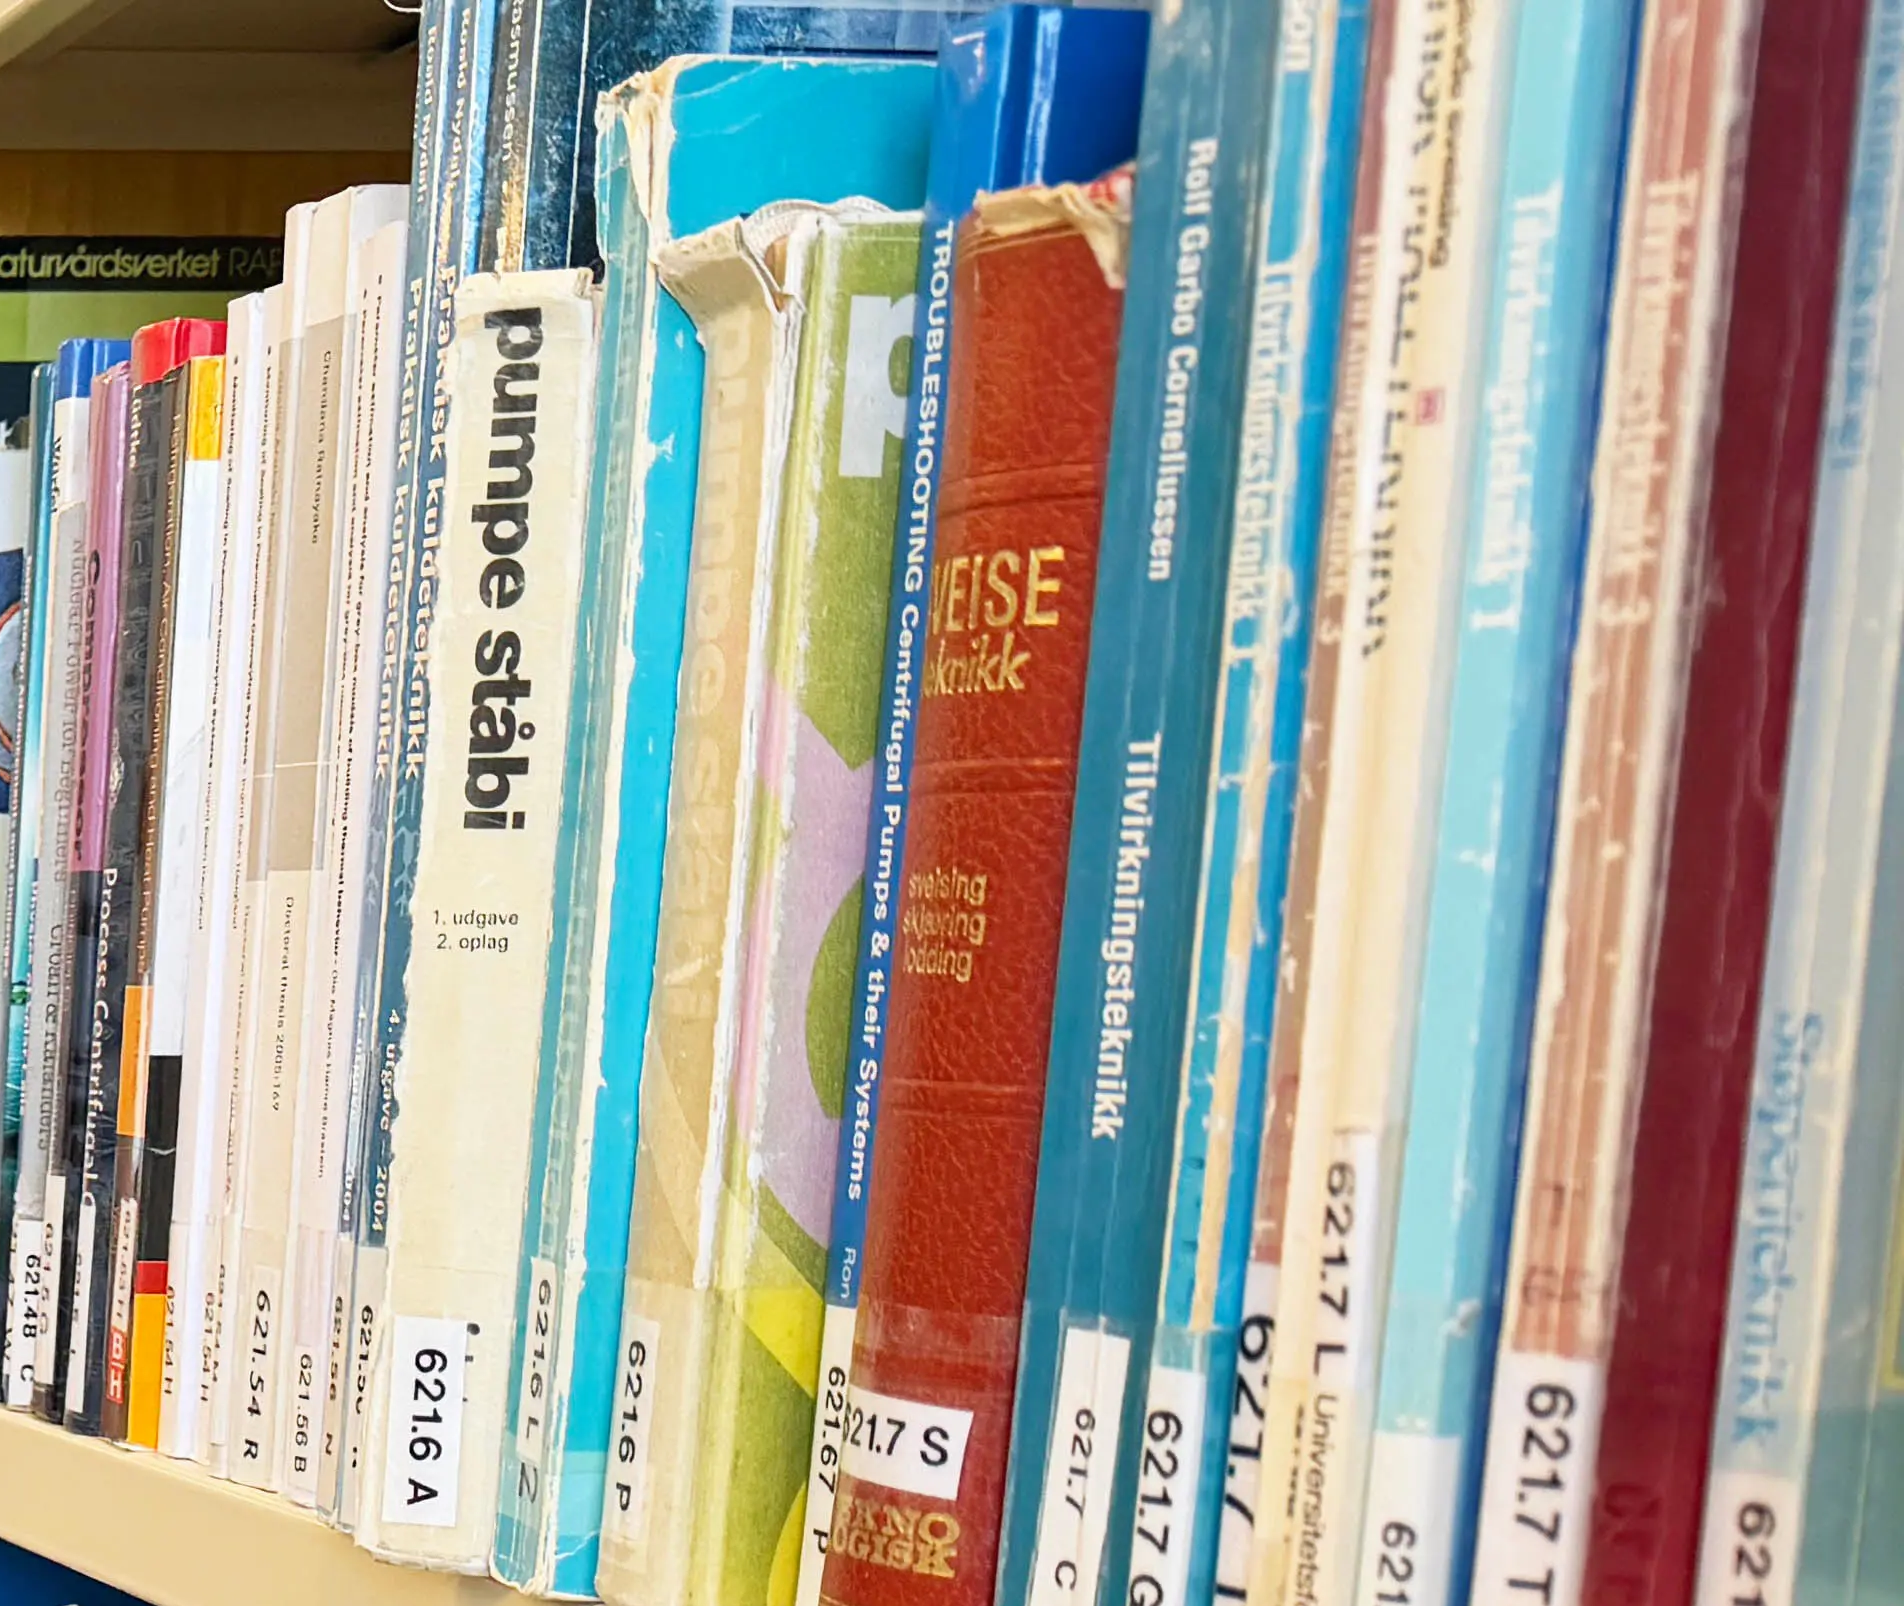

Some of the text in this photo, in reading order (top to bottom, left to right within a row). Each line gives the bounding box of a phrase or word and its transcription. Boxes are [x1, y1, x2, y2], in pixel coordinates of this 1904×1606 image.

[129, 385, 144, 469] Lüdtke
[1146, 139, 1219, 591] Rolf Garbo Corneliussen
[162, 581, 175, 617] Air
[373, 277, 424, 781] Praktisk kuldeteknikk
[404, 265, 457, 781] Praktisk kuldeteknikk
[462, 306, 545, 831] pumpe ståbi
[74, 549, 101, 862] Compressor
[844, 220, 955, 1202] TROUBLESHOOTING Centrifugal Pumps & their Systems
[432, 909, 520, 931] 1. udgave
[436, 932, 510, 954] 2. oplag
[907, 868, 988, 907] sveising
[1092, 731, 1163, 1139] Tilvirkningsteknikk
[80, 867, 118, 1180] Process Centrifugal
[371, 1009, 401, 1233] 4. utgave 2004
[19, 1253, 41, 1383] 621.48 C
[202, 1292, 215, 1373] 621.54
[529, 1278, 552, 1399] 621.6
[840, 1248, 858, 1300] Ron
[1314, 1159, 1357, 1376] 621.7 L
[243, 1289, 271, 1459] 621.54 R
[294, 1353, 313, 1472] 621.56 B
[329, 1295, 344, 1402] 621.56
[406, 1348, 449, 1506] 621.6 A
[526, 1415, 540, 1440] L
[615, 1339, 647, 1512] 621.6 P
[819, 1366, 846, 1495] 621.67
[842, 1403, 950, 1467] 621.7 S
[1054, 1408, 1096, 1592] 621.7 C
[1136, 1409, 1183, 1556] 621.7
[1505, 1382, 1578, 1606] 621.7 T
